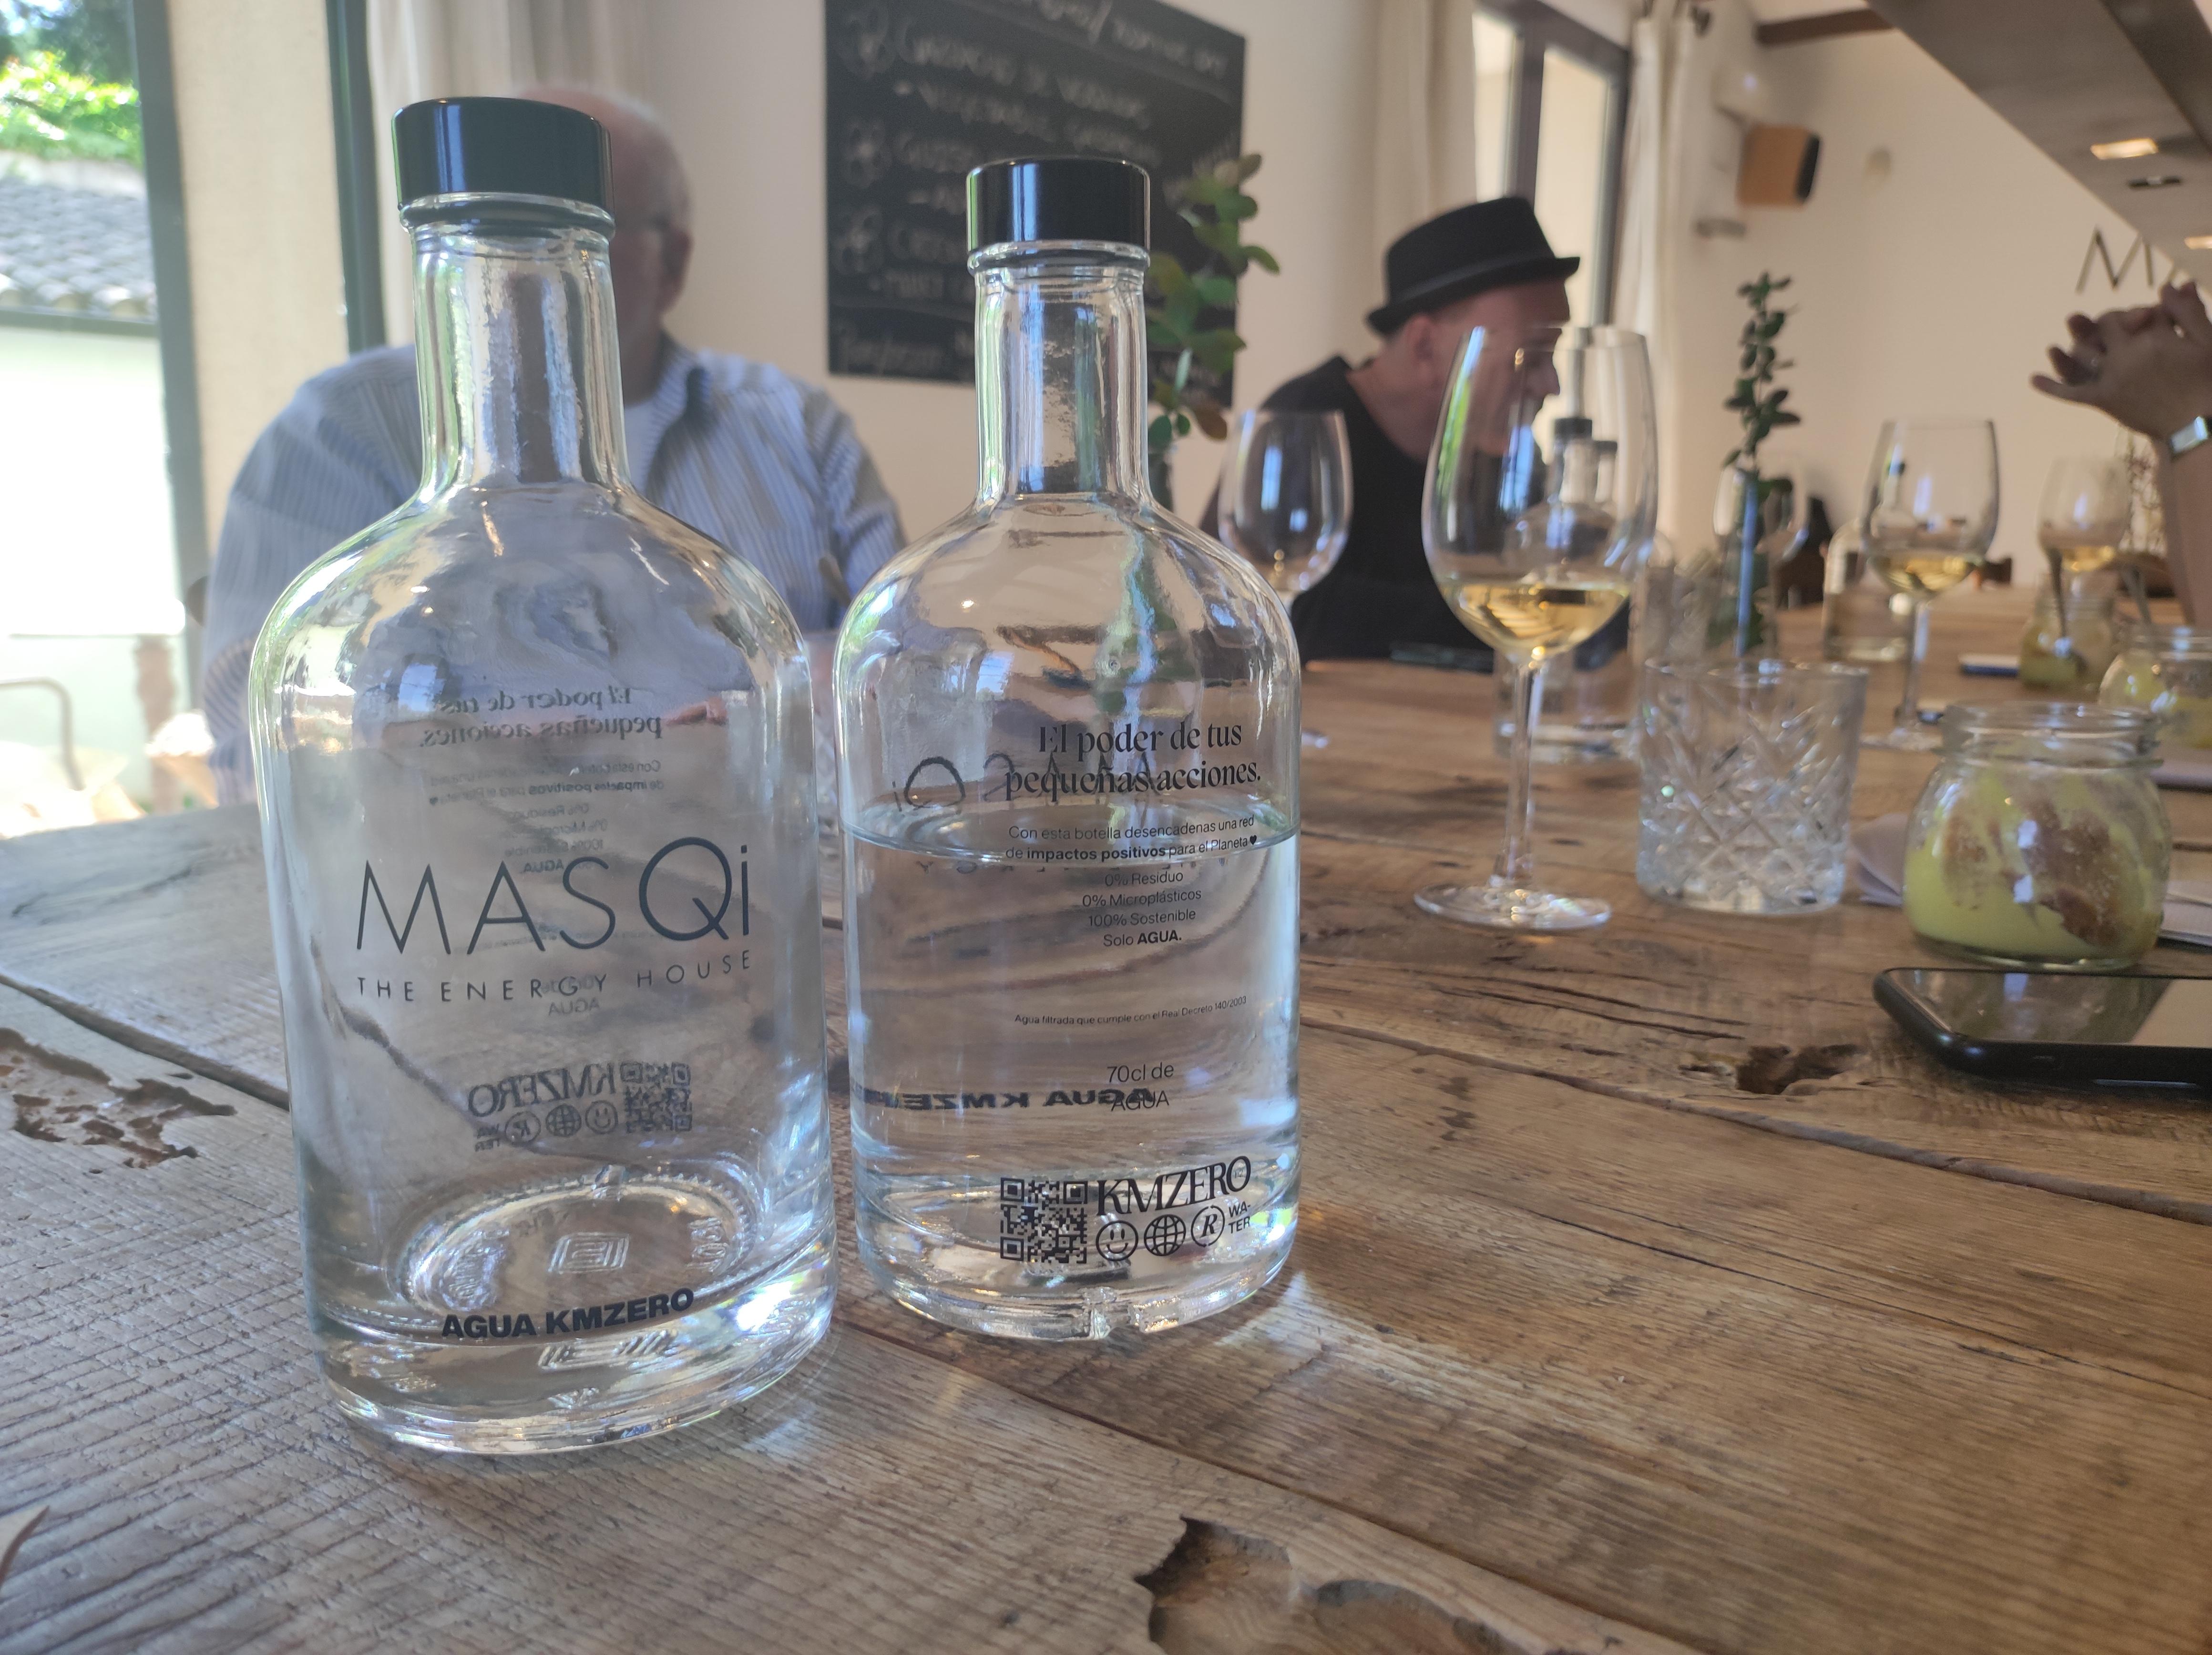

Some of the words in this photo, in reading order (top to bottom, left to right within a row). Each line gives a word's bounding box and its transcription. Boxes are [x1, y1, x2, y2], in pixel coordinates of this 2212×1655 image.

[1039, 724, 1067, 753] El
[1077, 723, 1163, 762] poder
[1170, 721, 1200, 750] de
[1208, 723, 1242, 747] tus
[1005, 766, 1148, 802] pequeñas
[1157, 761, 1260, 790] acciones.
[1009, 826, 1037, 838] Con
[1042, 828, 1071, 839] esta
[1075, 827, 1121, 839] botella
[1125, 822, 1216, 838] desencadenas
[1219, 820, 1237, 831] una
[1239, 814, 1254, 828] red
[1006, 847, 1023, 858] de
[1027, 848, 1096, 862] impactos
[1102, 846, 1166, 862] positivos
[1169, 845, 1196, 858] para
[1198, 840, 1208, 853] el
[1211, 837, 1248, 851] Planeta
[1105, 874, 1128, 887] 0%
[1132, 871, 1183, 885] Residuo
[1083, 894, 1106, 907] 0%
[1110, 890, 1201, 907] Microplásticos
[1089, 914, 1127, 927] 100%
[1130, 909, 1196, 926] Sostenible
[1104, 934, 1134, 947] Solo
[1137, 930, 1182, 944] AGUA.
[357, 977, 414, 1002] THE
[440, 974, 607, 1002] ENERGY
[637, 950, 750, 988] HOUSE
[1014, 1014, 1039, 1025] Agua
[1043, 1015, 1074, 1024] filtrada
[1077, 1016, 1095, 1025] que
[1097, 1014, 1132, 1024] cumple
[1134, 1013, 1150, 1022] con
[1153, 1011, 1160, 1020] el
[1162, 1009, 1180, 1018] Real
[1182, 1004, 1213, 1016] Decreto
[1215, 995, 1247, 1010] 140/2003
[1107, 1065, 1146, 1083] 70cl
[1151, 1062, 1174, 1079] de
[1111, 1090, 1170, 1112] AGUA
[1096, 1156, 1251, 1216] KMZERO
[1229, 1201, 1251, 1217] WA-
[1229, 1216, 1250, 1234] TER
[441, 1313, 537, 1339] AGUA
[545, 1288, 694, 1334] KMZERO
